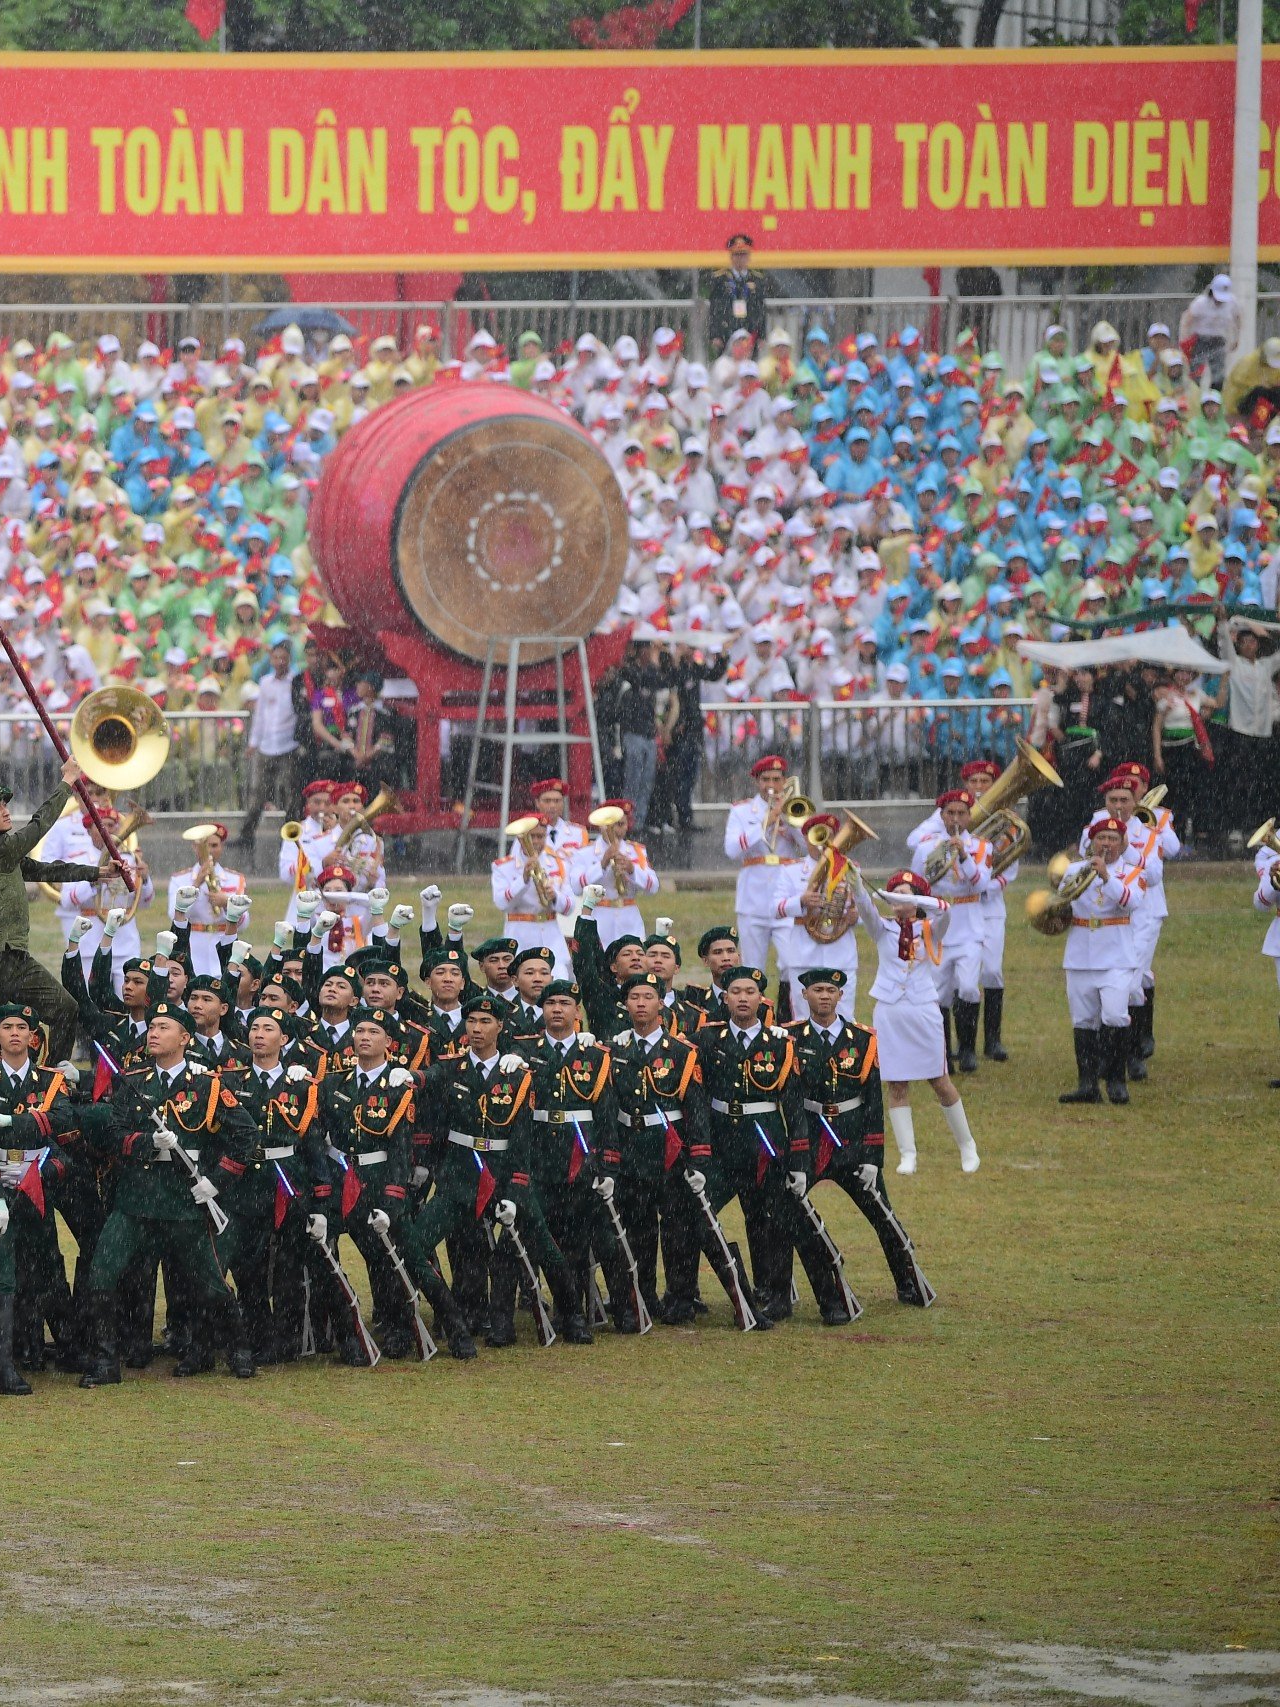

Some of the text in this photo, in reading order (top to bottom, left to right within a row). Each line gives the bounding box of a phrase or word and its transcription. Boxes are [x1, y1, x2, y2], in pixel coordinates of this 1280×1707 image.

[90, 107, 245, 217] TOÀN
[267, 107, 389, 216] DÂN
[410, 106, 538, 235] TỘC,
[558, 87, 675, 213] ĐẨY
[696, 123, 873, 231] MẠNH
[894, 103, 1048, 211] TOÀN
[1072, 101, 1211, 228] DIỆN
